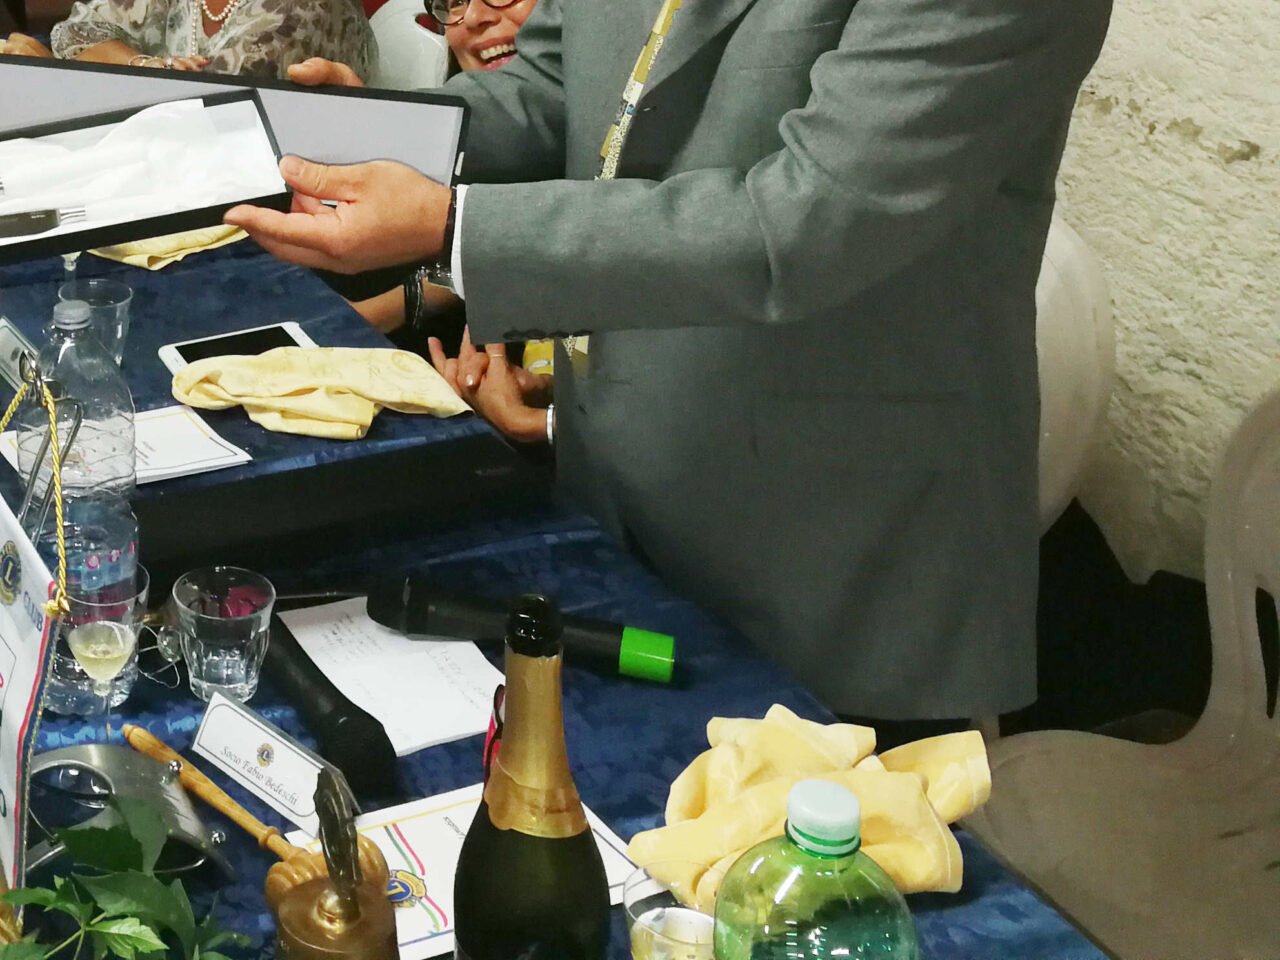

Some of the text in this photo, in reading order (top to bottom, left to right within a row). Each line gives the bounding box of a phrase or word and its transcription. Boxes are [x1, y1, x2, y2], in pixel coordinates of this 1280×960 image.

[24, 590, 44, 632] CLUB
[221, 746, 298, 806] Socio Fabio Bedeschi
